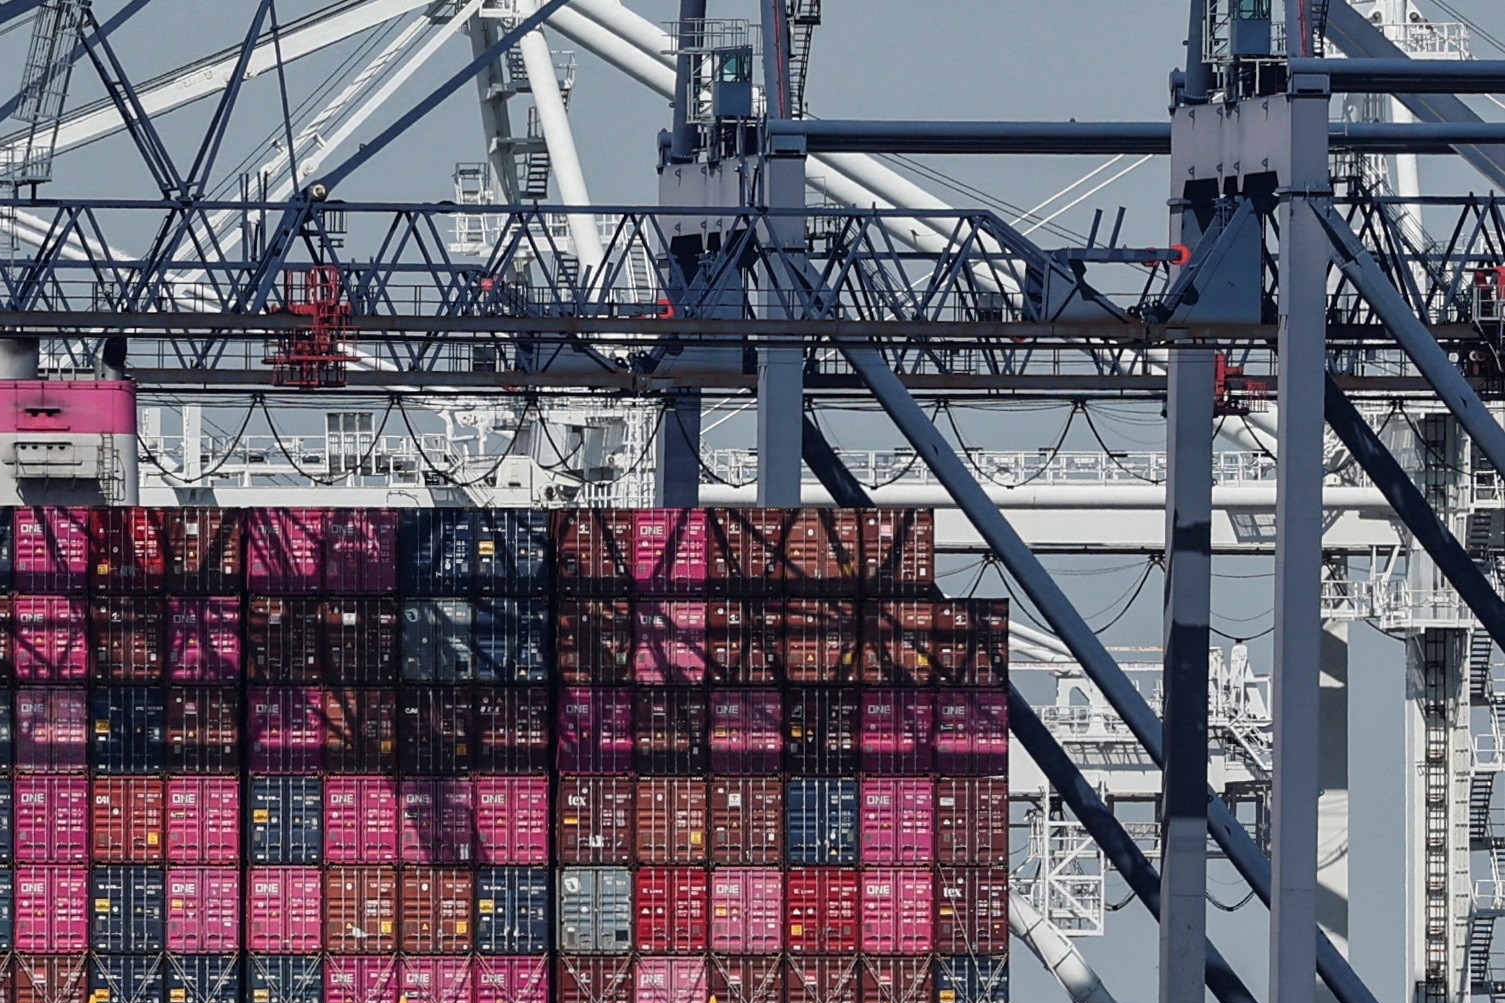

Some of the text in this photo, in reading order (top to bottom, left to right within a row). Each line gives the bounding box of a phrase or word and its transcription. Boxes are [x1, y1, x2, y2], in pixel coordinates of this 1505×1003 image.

[20, 523, 43, 534] ONE
[256, 524, 279, 534] ONE
[331, 524, 354, 534] ONE
[640, 526, 663, 535] ONE
[20, 613, 43, 623] ONE
[174, 614, 196, 624] ONE
[640, 615, 664, 624] ONE
[21, 704, 44, 713] ONE
[256, 704, 279, 714] ONE
[566, 705, 589, 714] ONE
[716, 705, 739, 715] ONE
[868, 705, 891, 715] ONE
[942, 706, 965, 715] ONE
[21, 793, 44, 803] ONE
[172, 794, 196, 804] ONE
[330, 794, 354, 804] ONE
[406, 794, 429, 804] ONE
[481, 794, 504, 804] ONE
[568, 795, 587, 806] tex
[866, 795, 890, 805] ONE
[21, 883, 44, 893] ONE
[172, 883, 195, 893] ONE
[255, 883, 278, 893] ONE
[716, 885, 739, 894] ONE
[866, 885, 890, 894] ONE
[944, 886, 962, 898] tex
